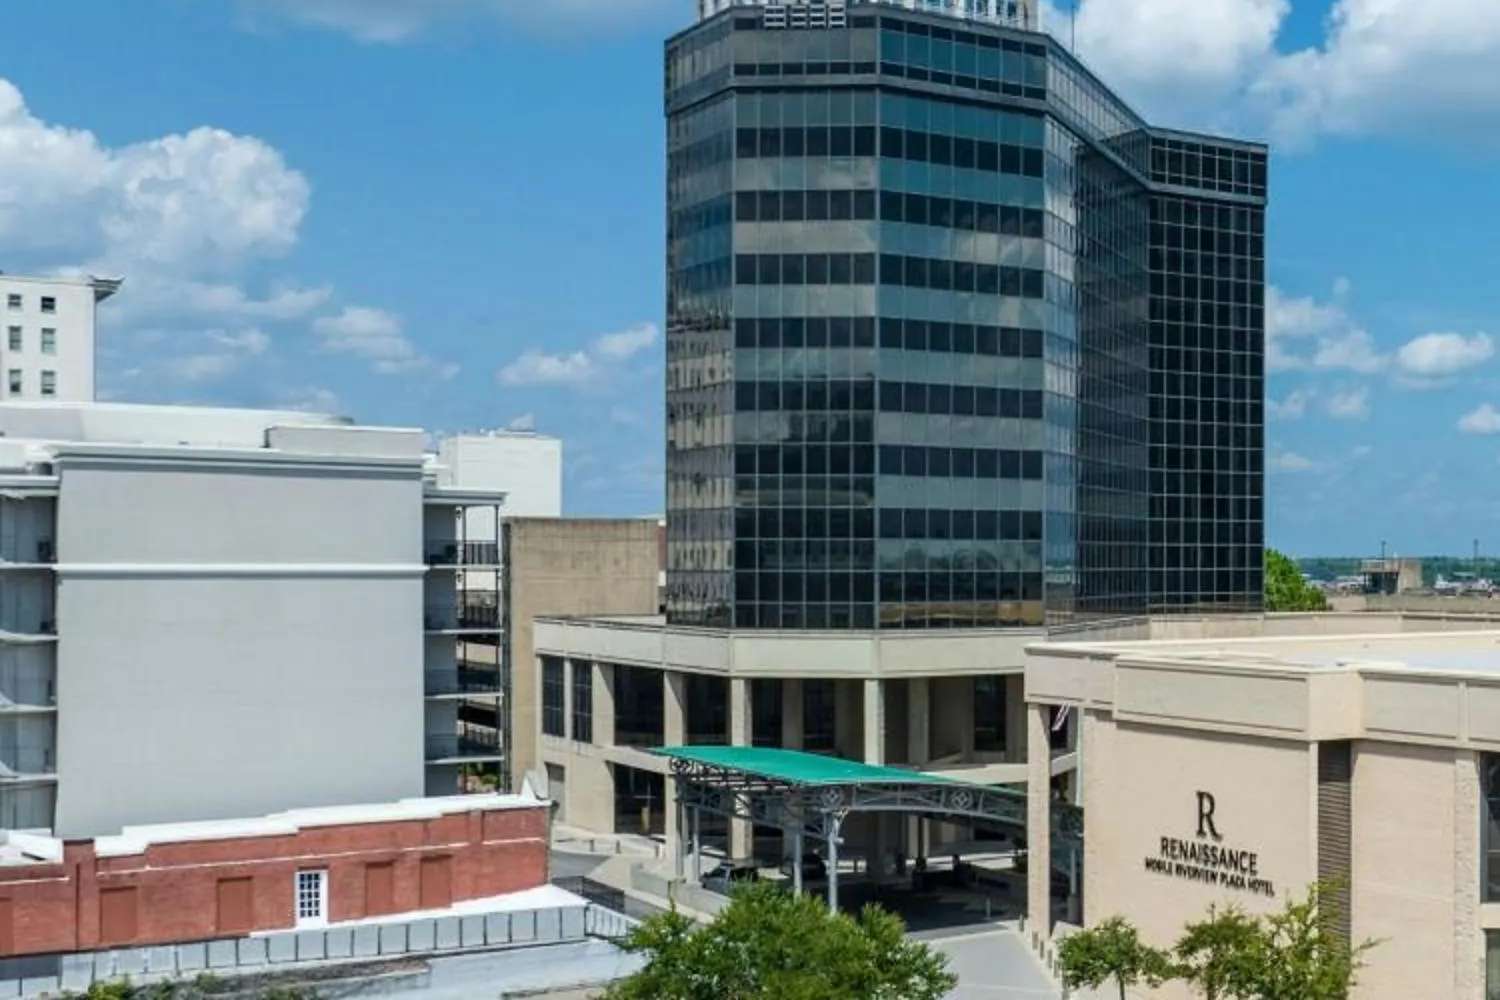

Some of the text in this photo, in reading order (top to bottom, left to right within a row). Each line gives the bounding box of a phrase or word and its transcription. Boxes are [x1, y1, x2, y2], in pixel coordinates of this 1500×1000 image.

[1196, 790, 1223, 841] R
[1145, 856, 1173, 876] MOBILE
[1220, 869, 1246, 889] PLAZA
[1248, 877, 1275, 897] HOTEL
[1160, 837, 1258, 876] RENAISSANCE
